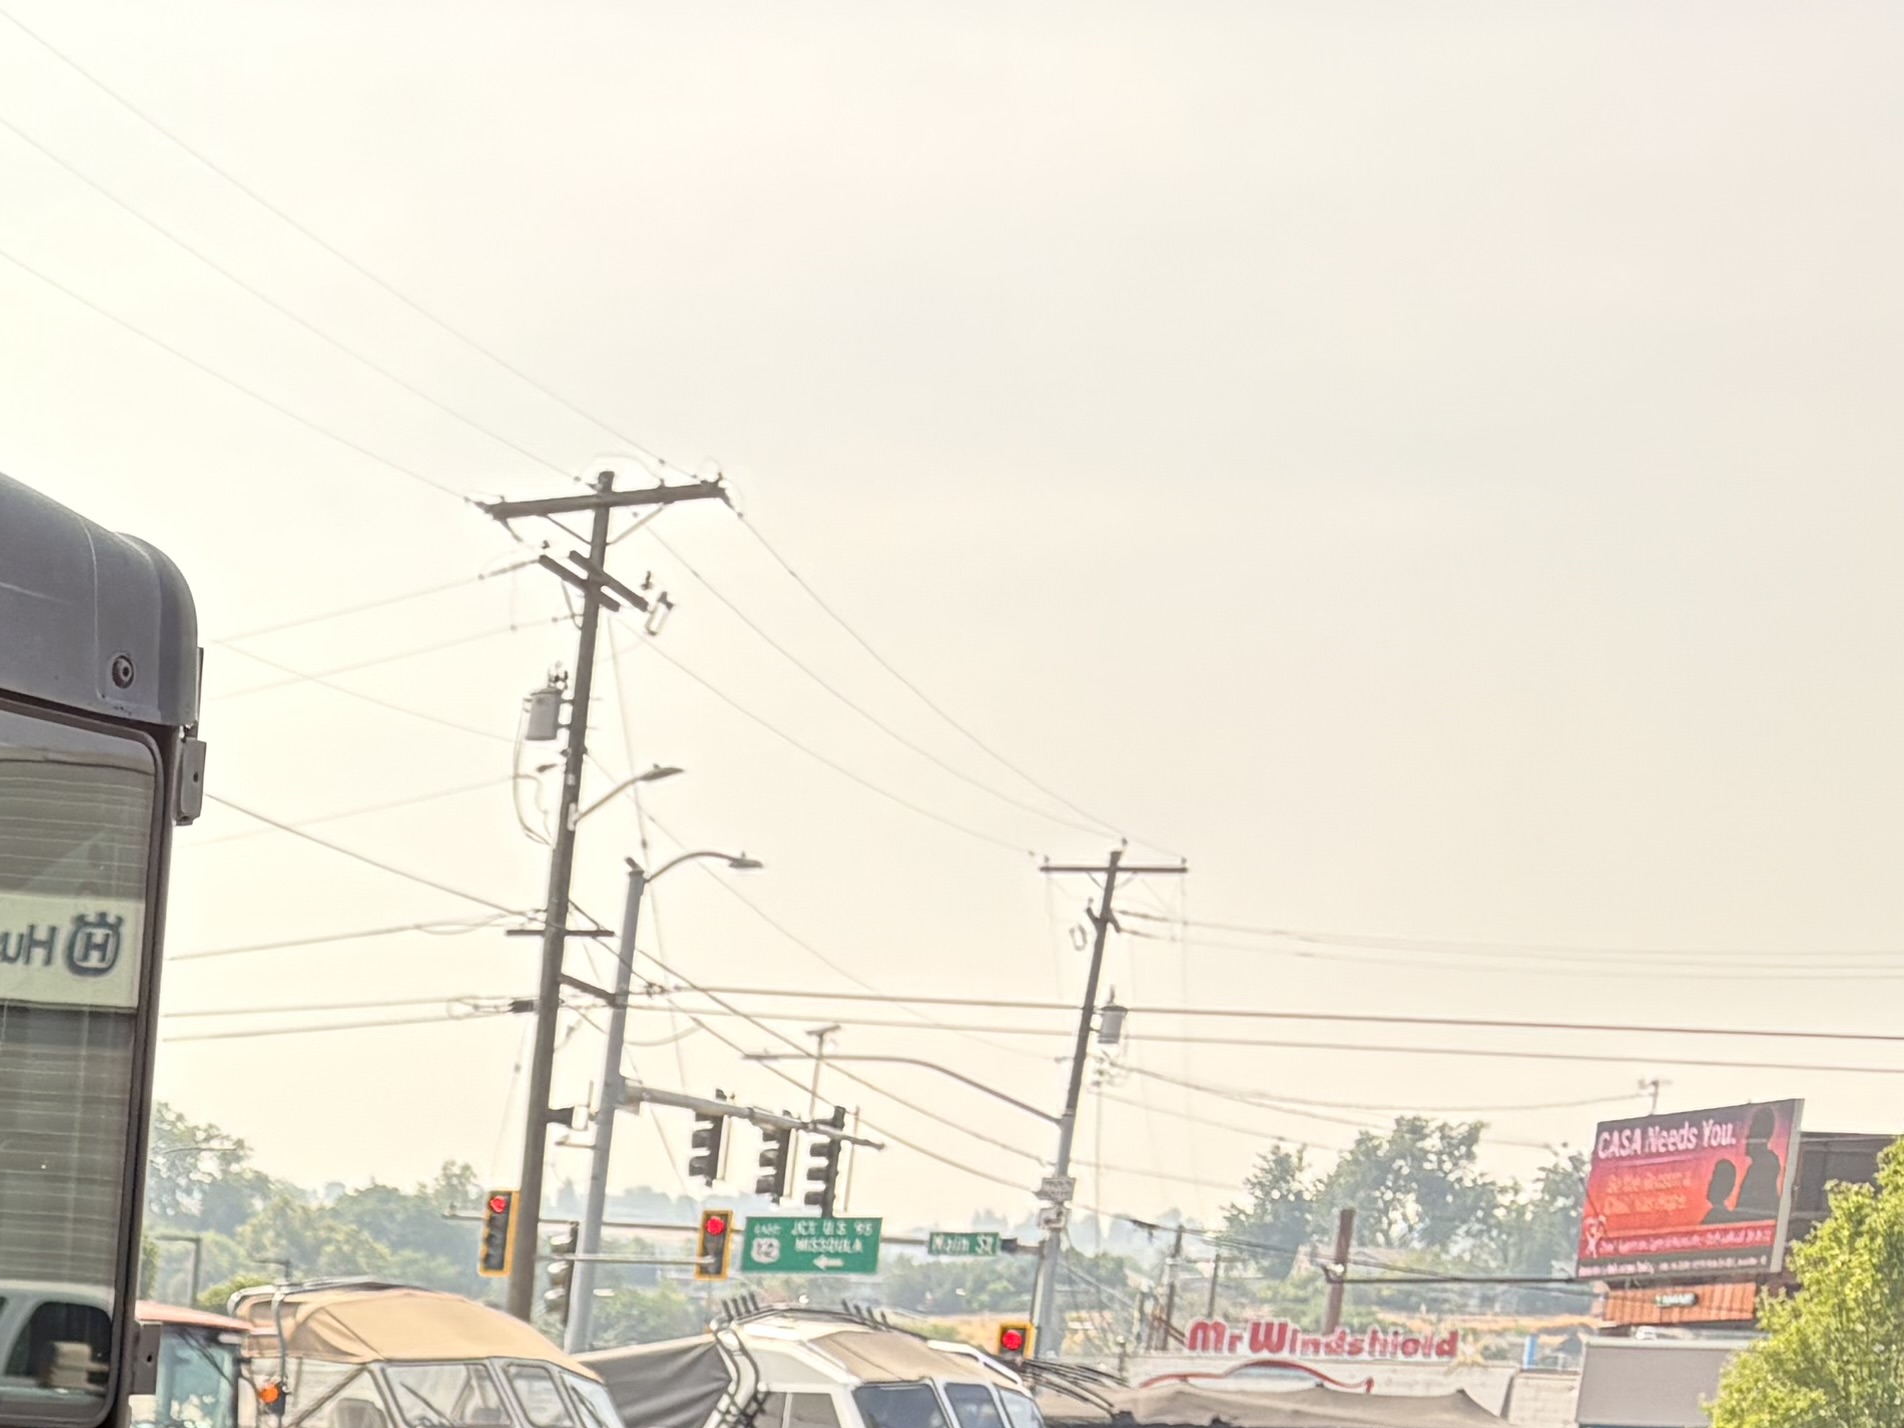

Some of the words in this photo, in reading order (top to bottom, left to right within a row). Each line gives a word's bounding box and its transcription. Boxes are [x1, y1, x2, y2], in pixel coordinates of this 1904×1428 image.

[1597, 1128, 1643, 1160] CASA
[1645, 1122, 1699, 1153] Needs
[1702, 1118, 1737, 1148] You.
[1188, 1321, 1243, 1354] Mr
